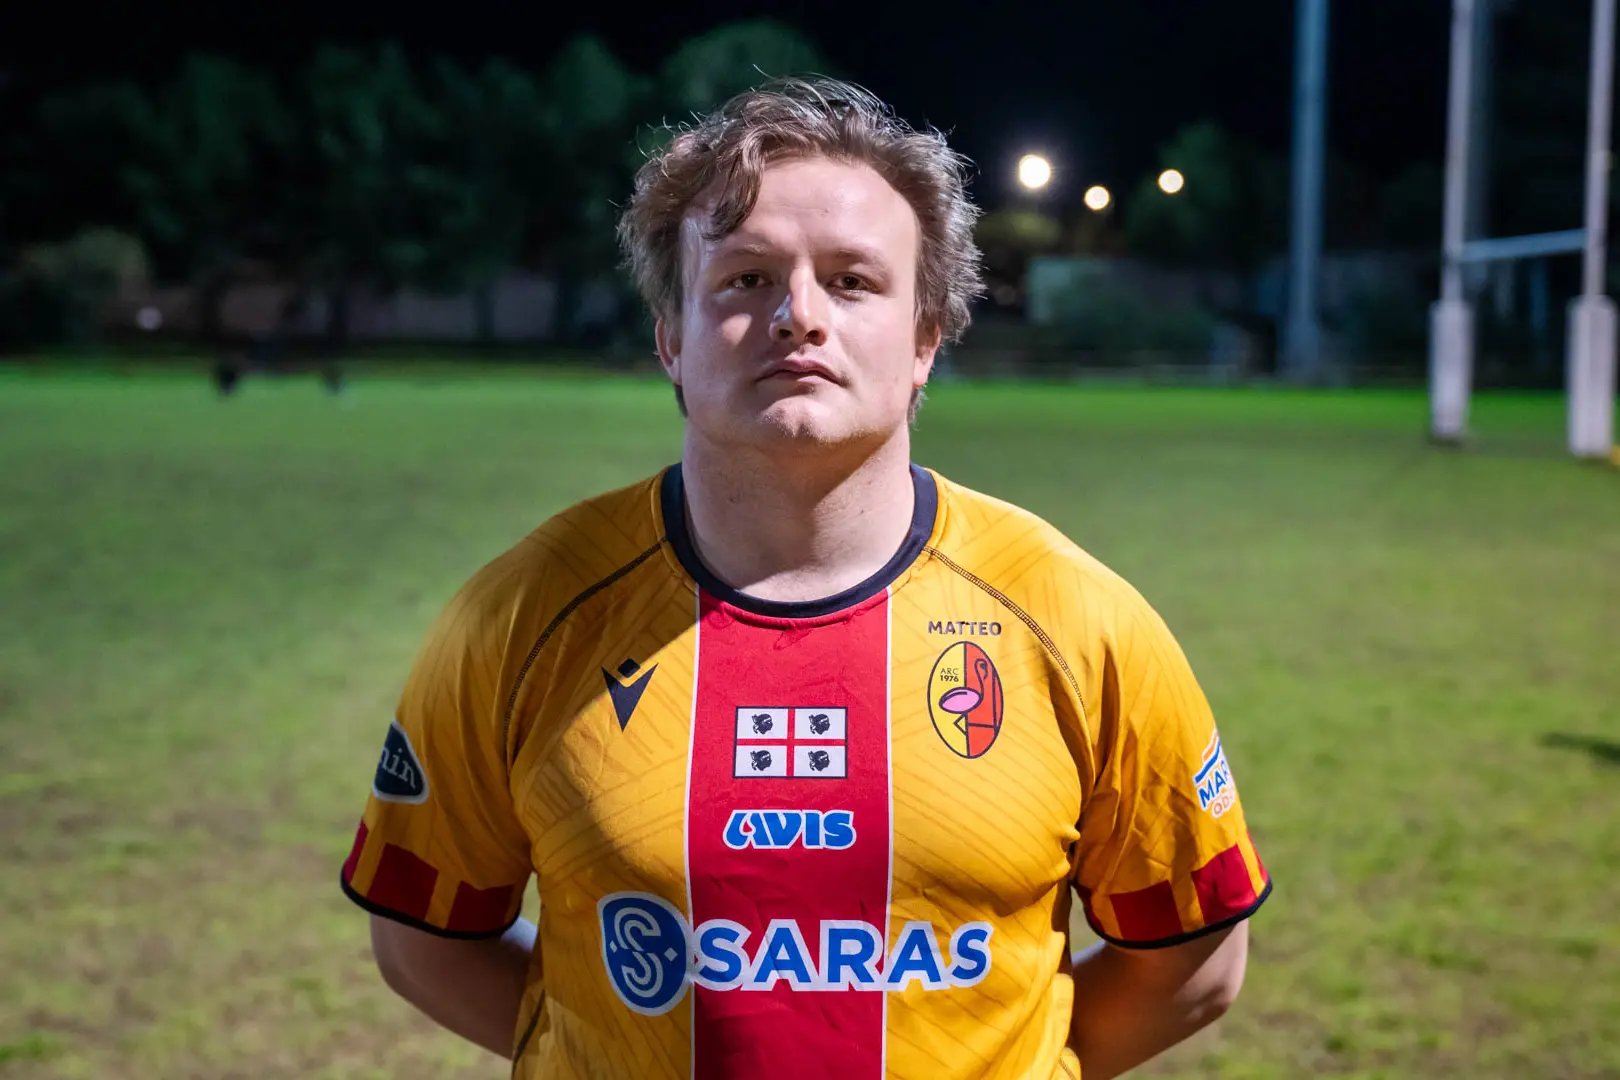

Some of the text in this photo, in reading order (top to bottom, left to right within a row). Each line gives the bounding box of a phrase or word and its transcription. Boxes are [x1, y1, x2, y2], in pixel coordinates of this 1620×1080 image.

[928, 620, 1002, 636] MATTEO
[940, 667, 959, 675] ARC
[724, 810, 856, 849] AVIS
[695, 921, 991, 988] SARAS
